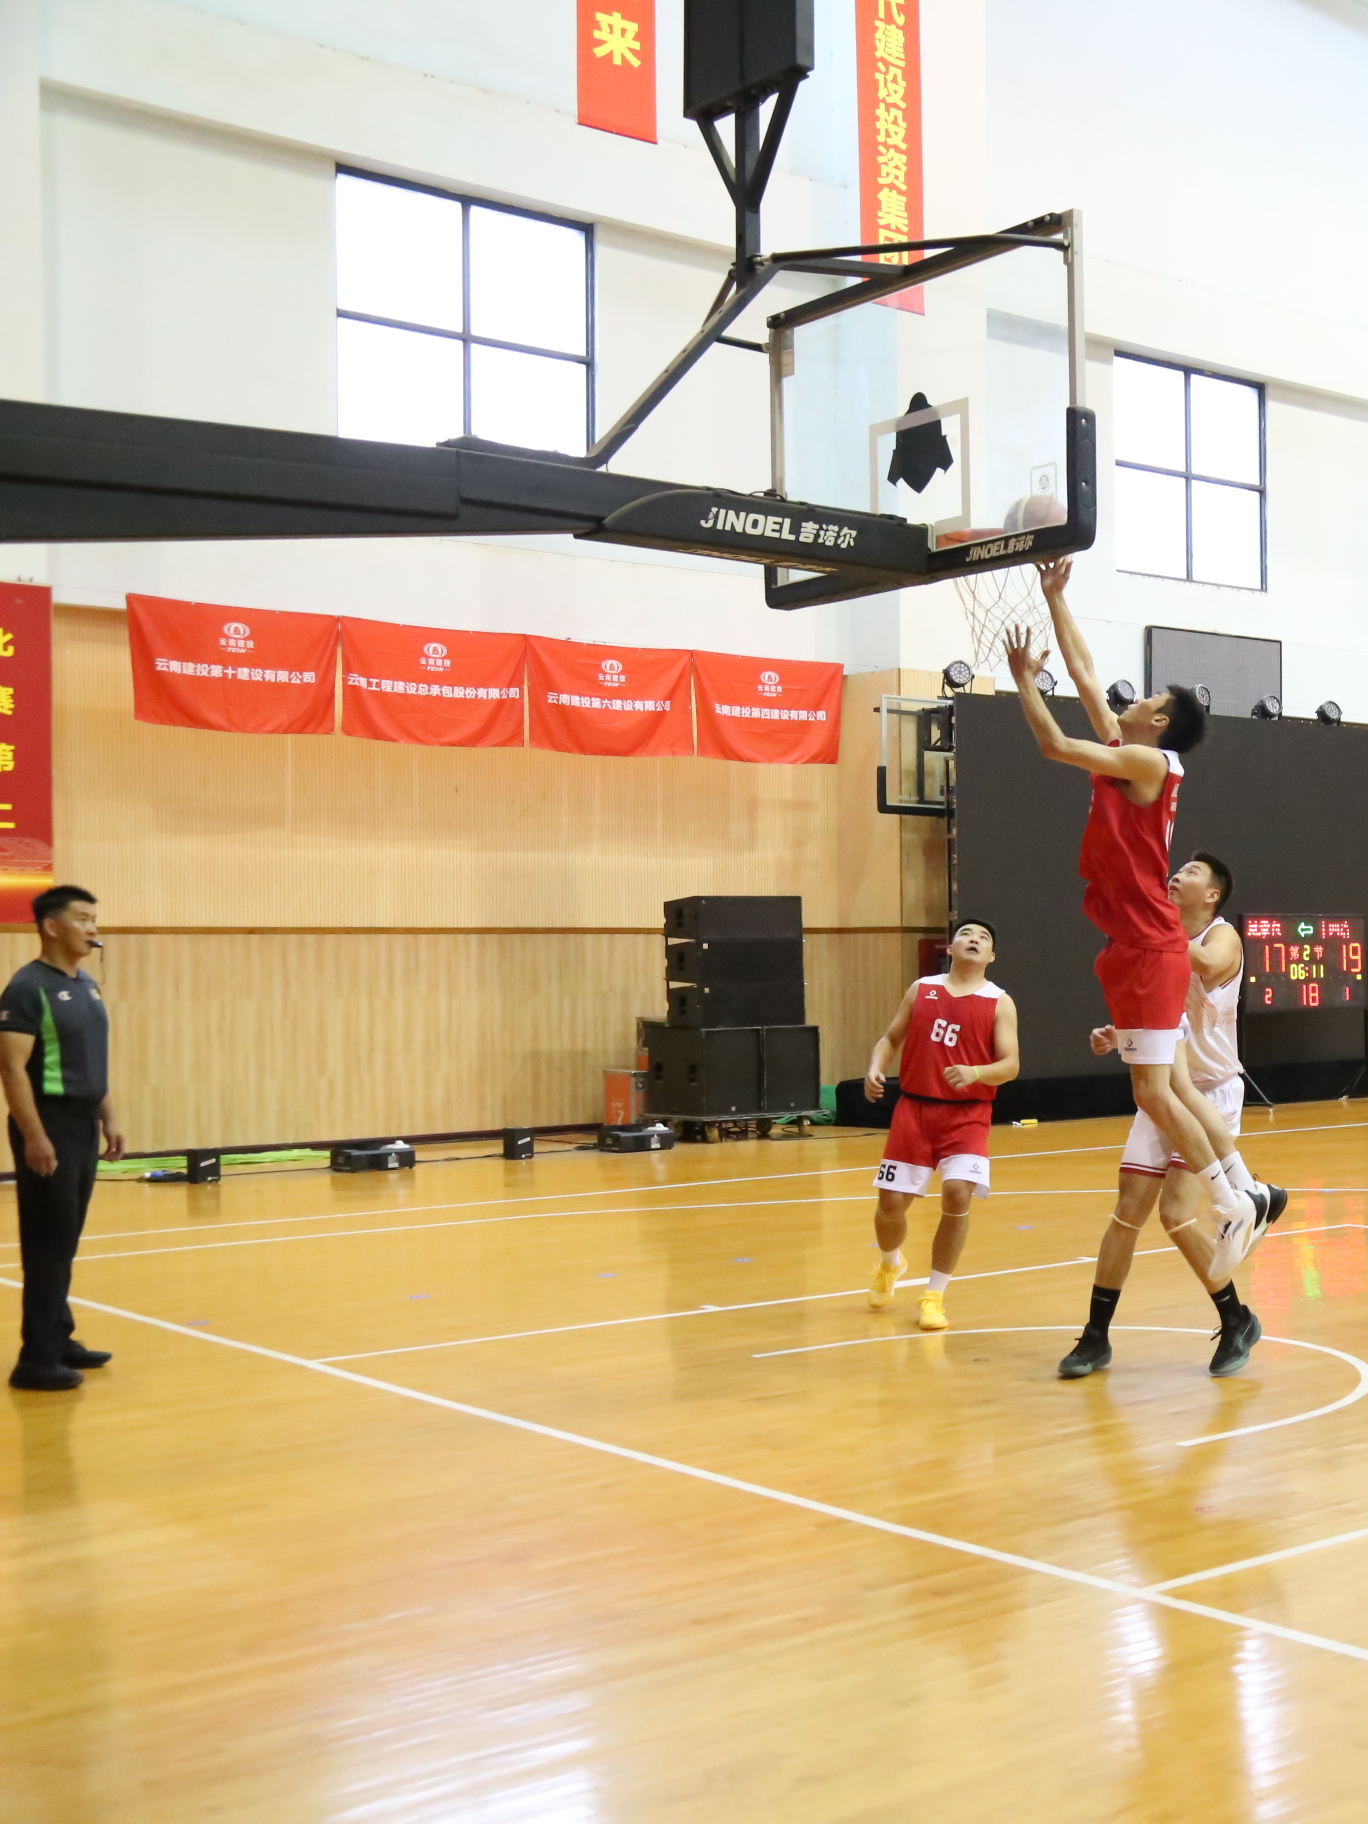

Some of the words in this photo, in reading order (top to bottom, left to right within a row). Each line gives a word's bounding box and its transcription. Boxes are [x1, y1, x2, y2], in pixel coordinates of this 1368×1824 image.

[700, 506, 796, 542] JINOEL
[799, 520, 858, 549] 吉诺尔
[966, 539, 1007, 562] JINOEL
[1007, 534, 1035, 554] 吉诺尔
[155, 658, 316, 684] 云南建投第十建设有限公司
[347, 672, 520, 700] 云南工程建设总承包股份有限公司
[547, 691, 671, 712] 云南建投第六建设有限公司
[714, 702, 827, 721] 云南建投第四建设有限公司
[1265, 943, 1286, 972] 17
[1343, 943, 1362, 973] 19
[1290, 964, 1324, 980] 06:11
[1264, 987, 1272, 1004] 2
[1302, 983, 1319, 1006] 18
[930, 1019, 961, 1047] 66
[877, 1163, 897, 1182] 66
